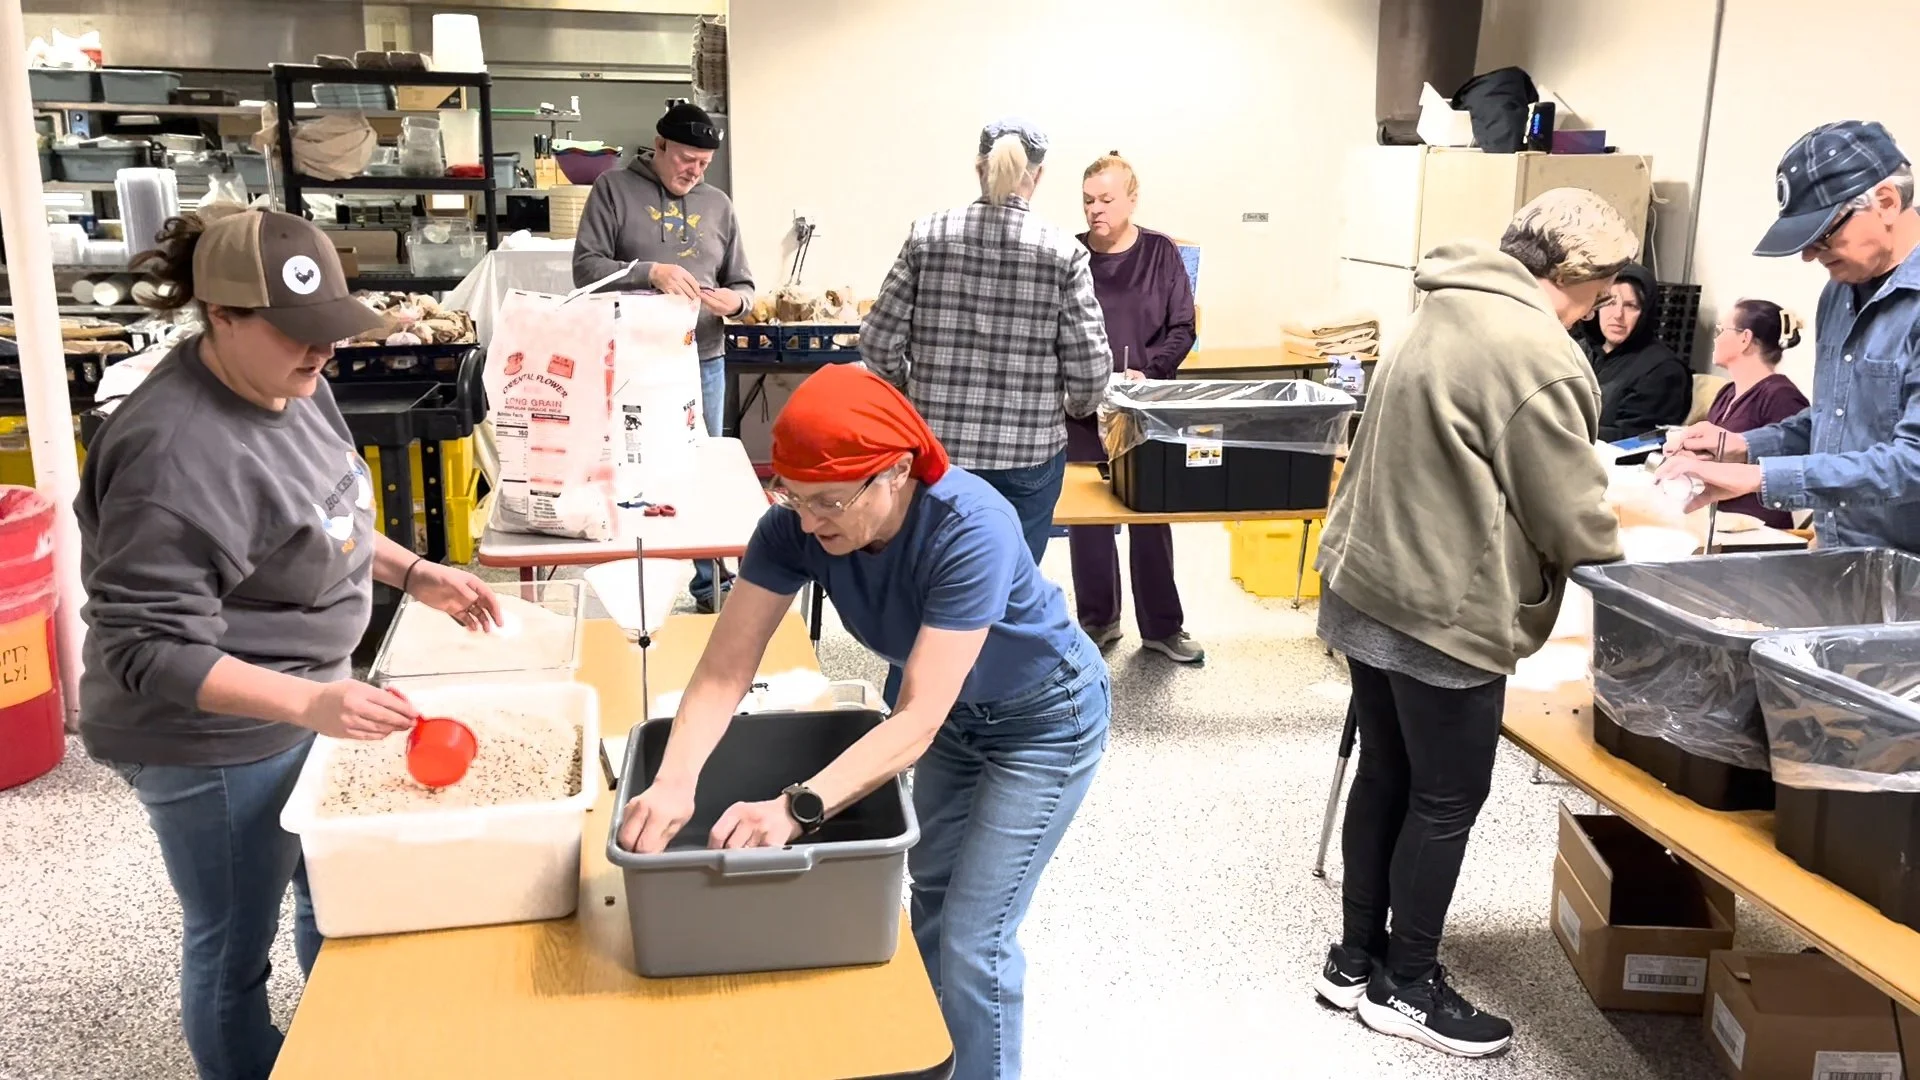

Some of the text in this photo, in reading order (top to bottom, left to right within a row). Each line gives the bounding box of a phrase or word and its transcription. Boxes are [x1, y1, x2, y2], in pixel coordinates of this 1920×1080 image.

[536, 374, 568, 398] FLOWER
[505, 397, 562, 408] LONG GRAIN
[1386, 995, 1428, 1025] HOKA
